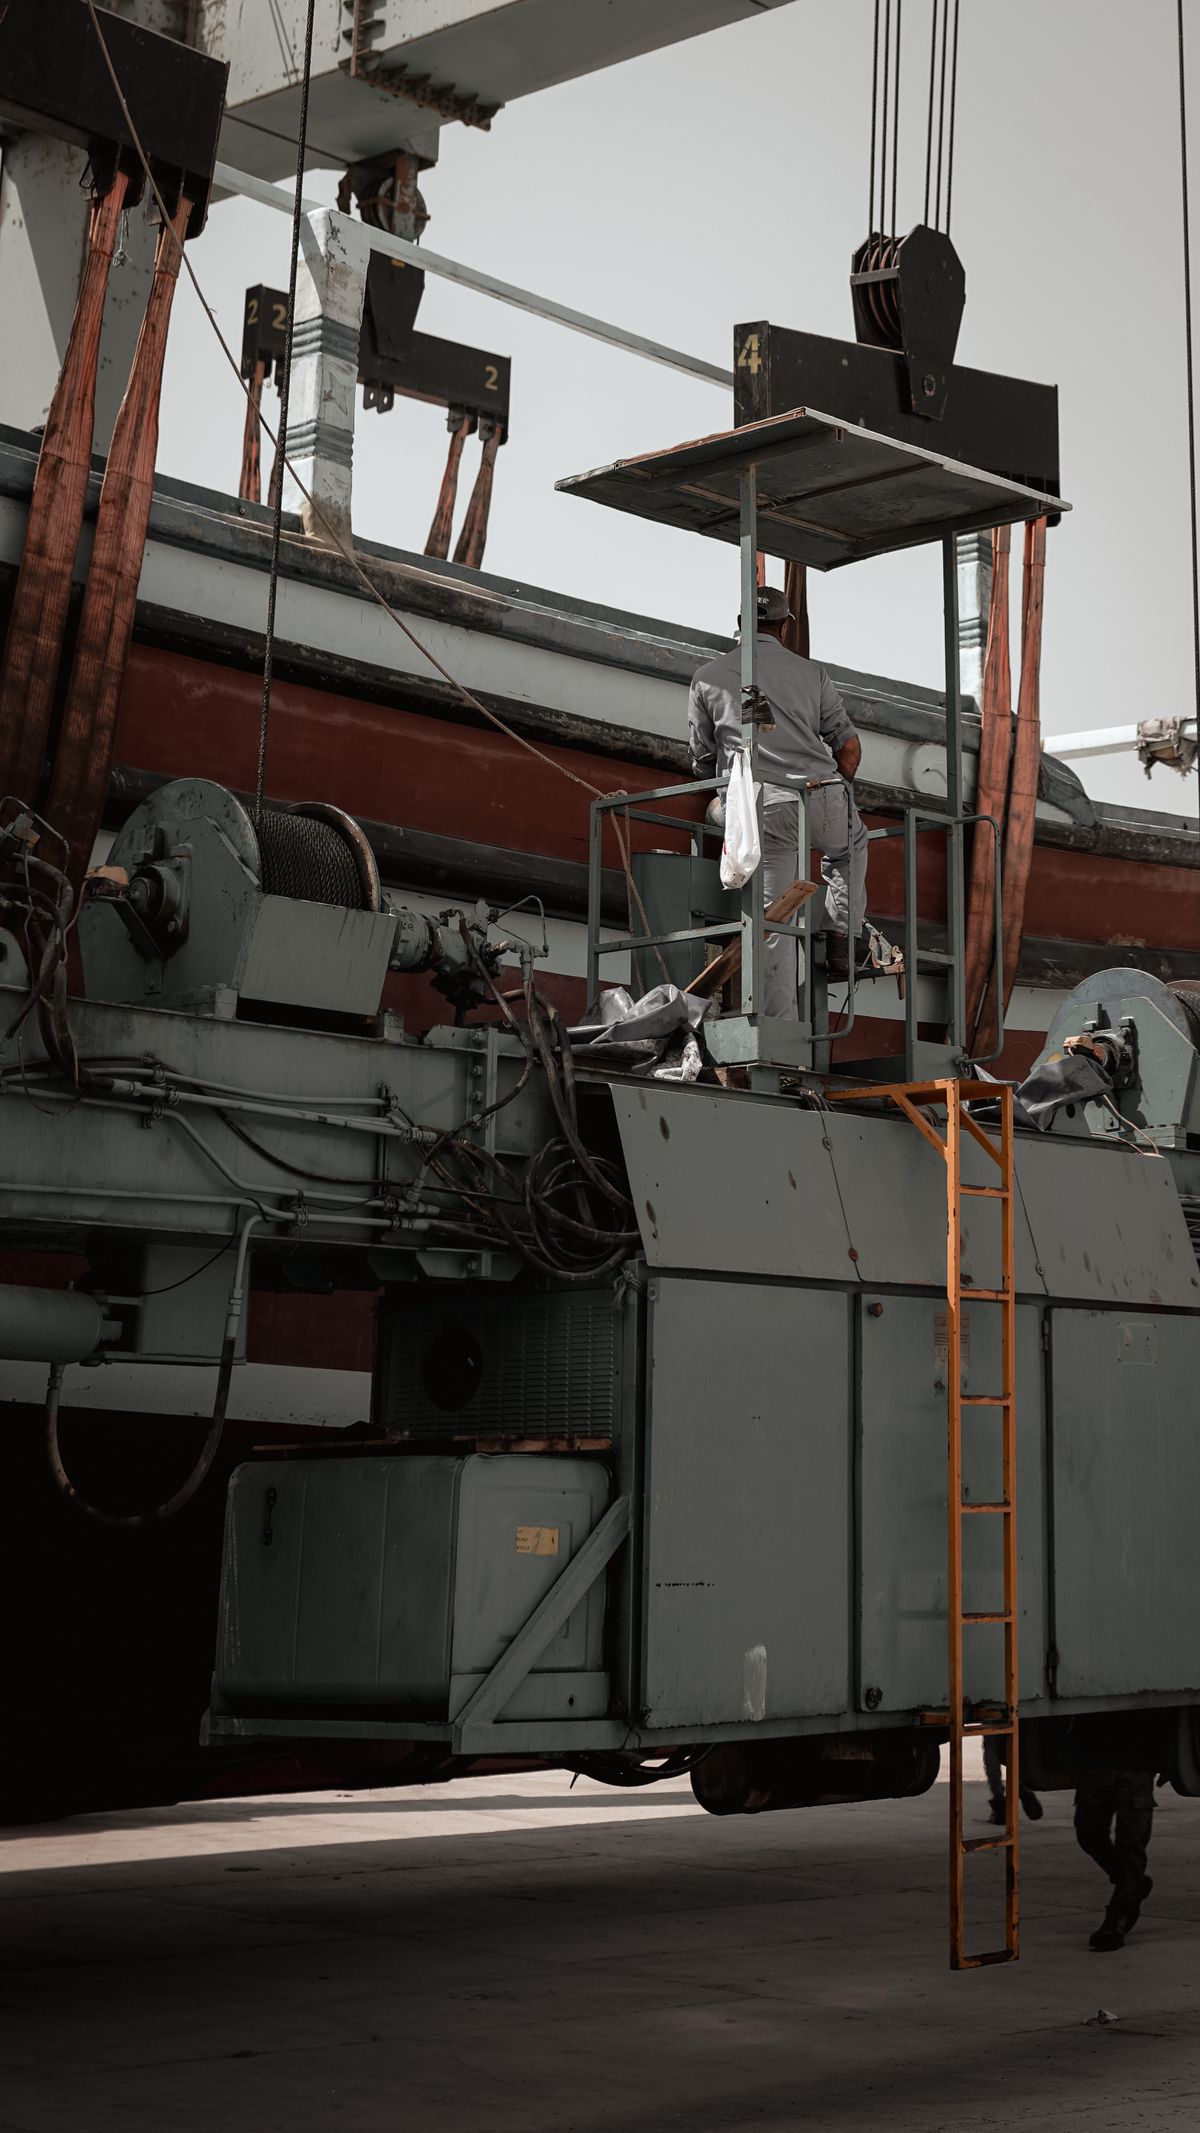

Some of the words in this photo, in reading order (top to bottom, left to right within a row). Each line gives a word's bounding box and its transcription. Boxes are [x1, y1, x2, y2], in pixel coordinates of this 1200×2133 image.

[247, 298, 259, 326] 2
[272, 303, 288, 331] 2
[738, 333, 762, 374] 4
[484, 365, 498, 391] 2
